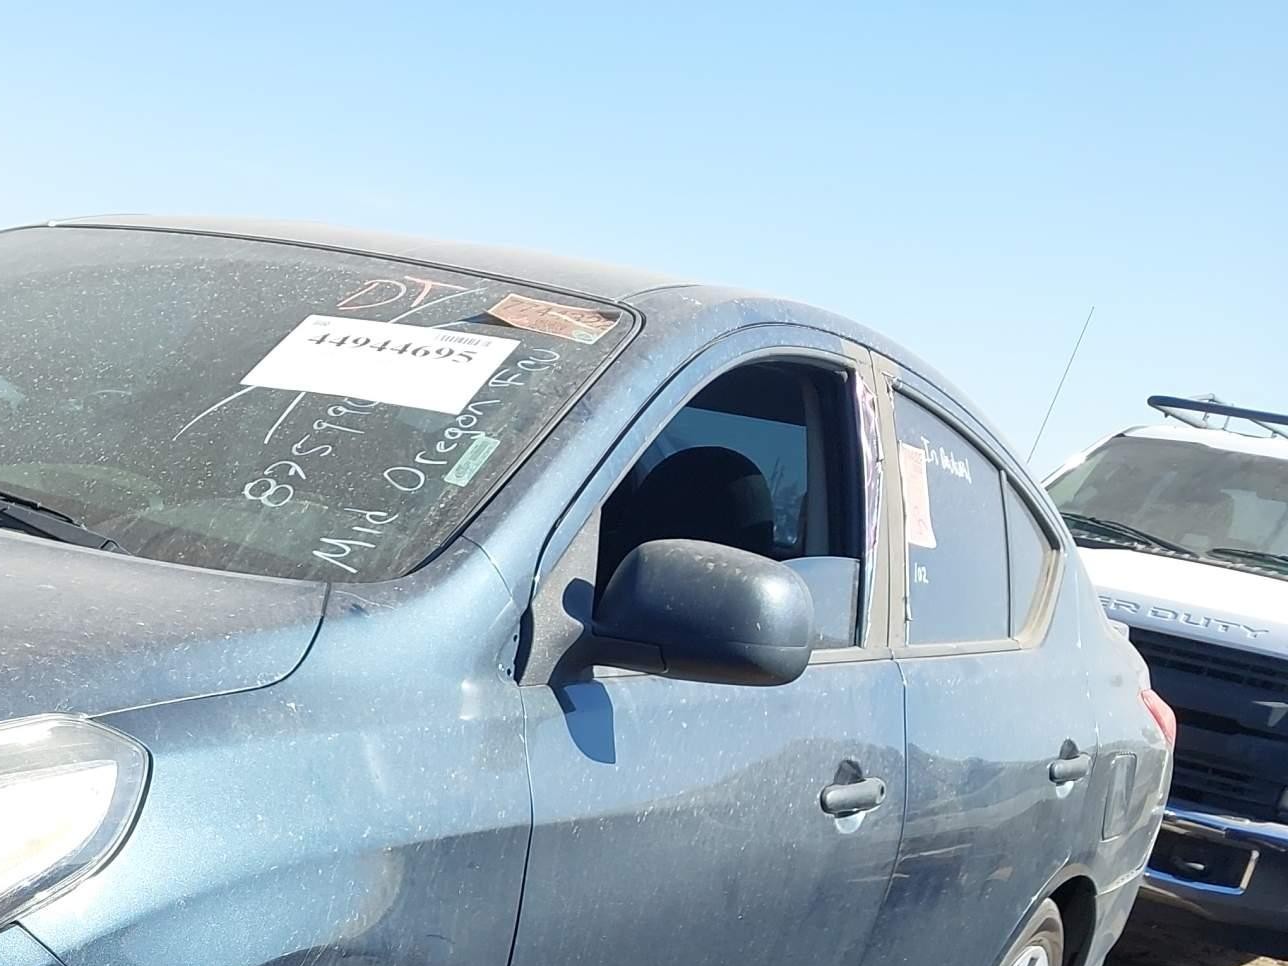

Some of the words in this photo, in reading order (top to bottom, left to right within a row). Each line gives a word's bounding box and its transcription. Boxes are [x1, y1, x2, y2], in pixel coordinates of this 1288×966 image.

[306, 331, 479, 364] 44944695
[312, 507, 400, 574] Mid
[383, 399, 501, 492] Oregon
[1098, 594, 1141, 615] ER
[1147, 605, 1270, 639] DUTY
